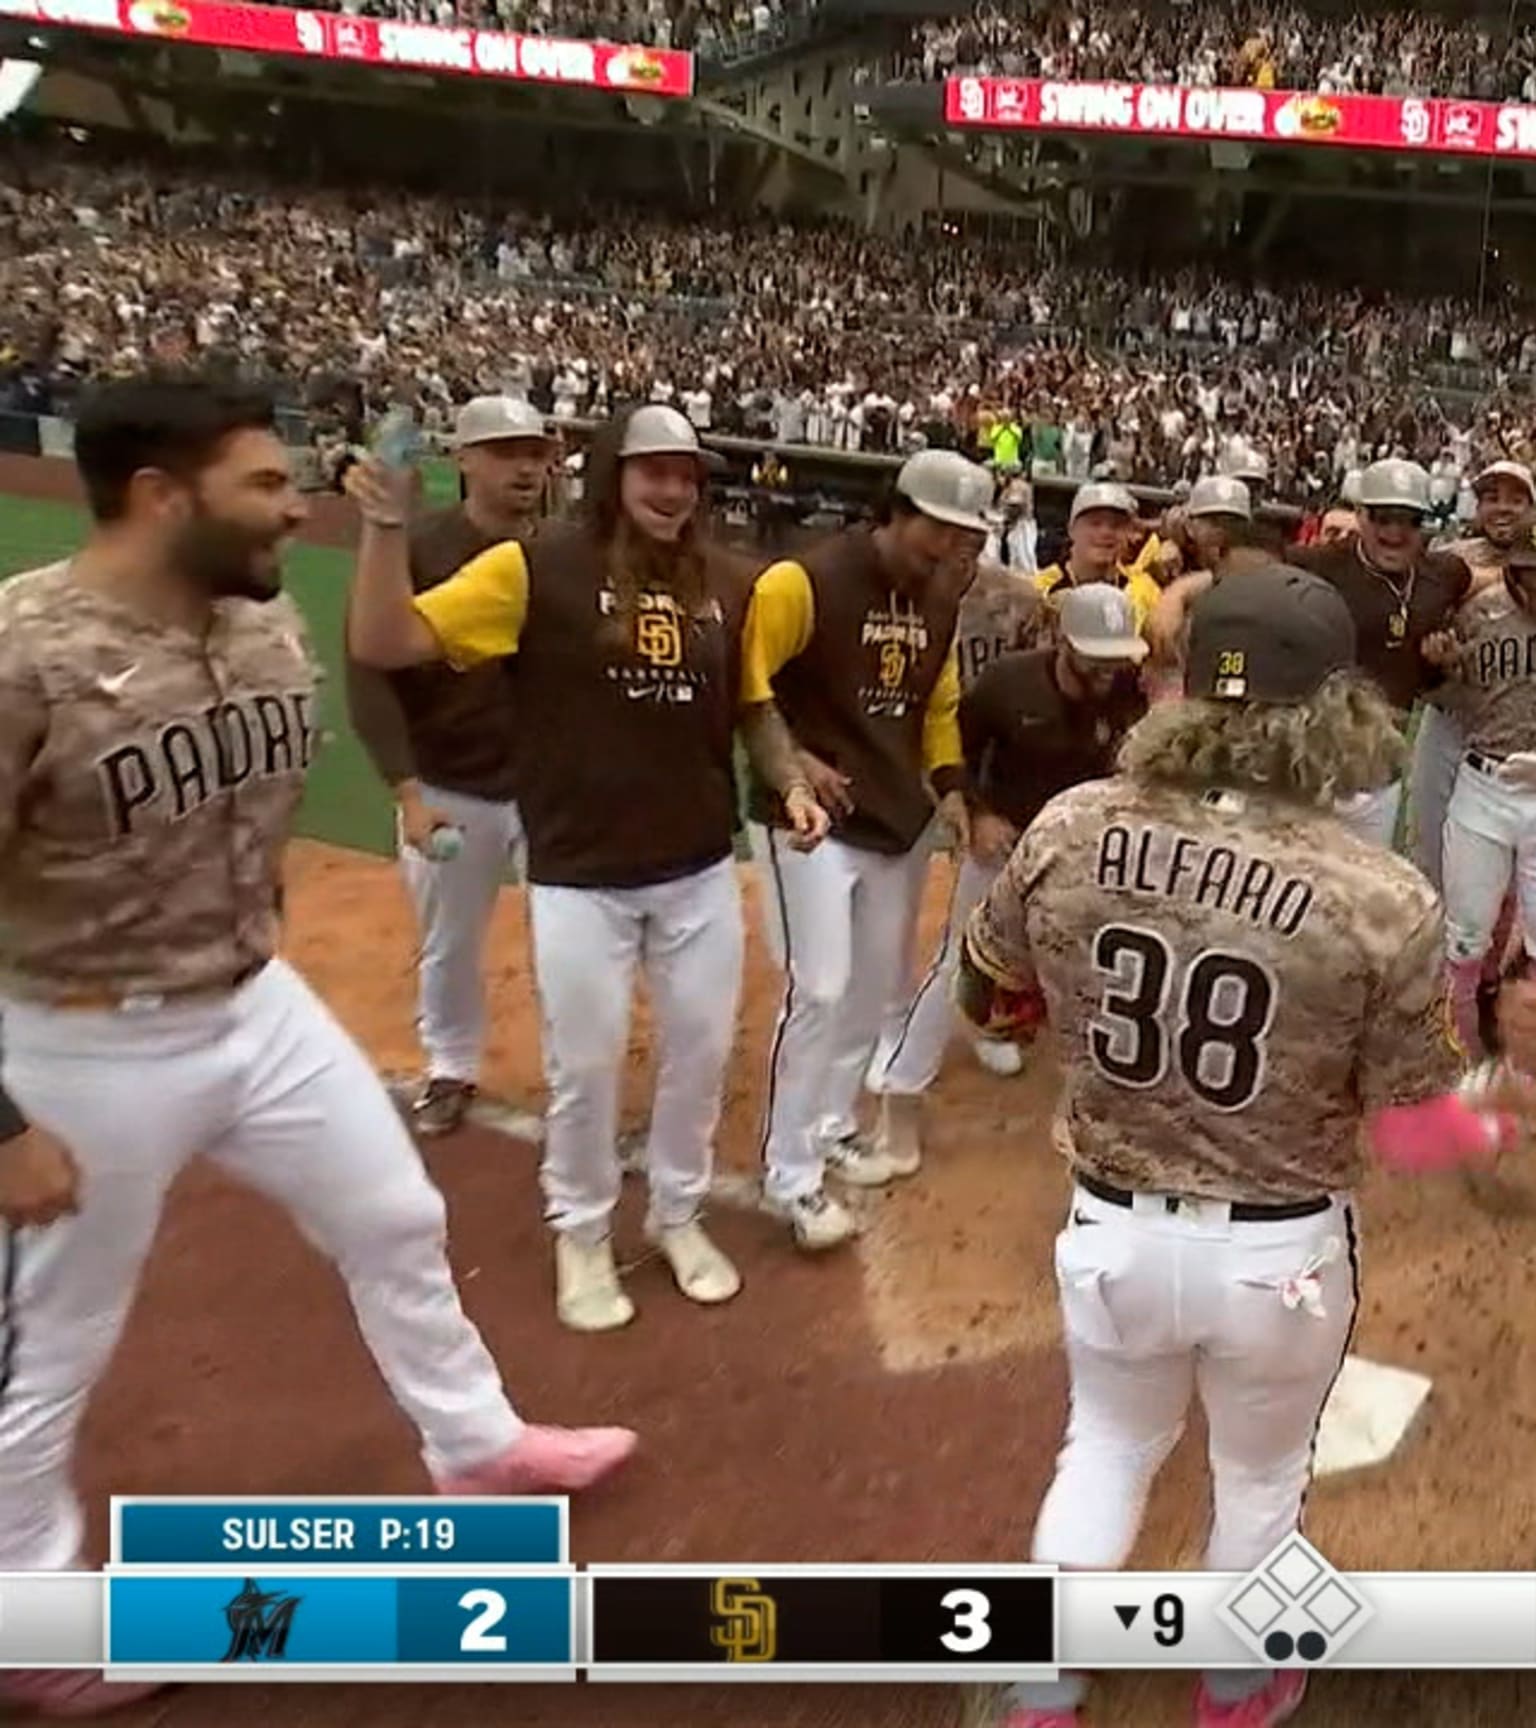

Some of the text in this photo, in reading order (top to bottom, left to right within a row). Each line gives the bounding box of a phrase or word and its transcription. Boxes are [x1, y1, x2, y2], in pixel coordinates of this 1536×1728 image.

[1039, 82, 1134, 127] SWING
[1138, 85, 1181, 130] ON
[1185, 89, 1265, 134] OVER
[638, 613, 682, 667] SD
[1219, 651, 1244, 675] 38
[1098, 826, 1315, 939] ALFARO
[1090, 922, 1278, 1113] 38
